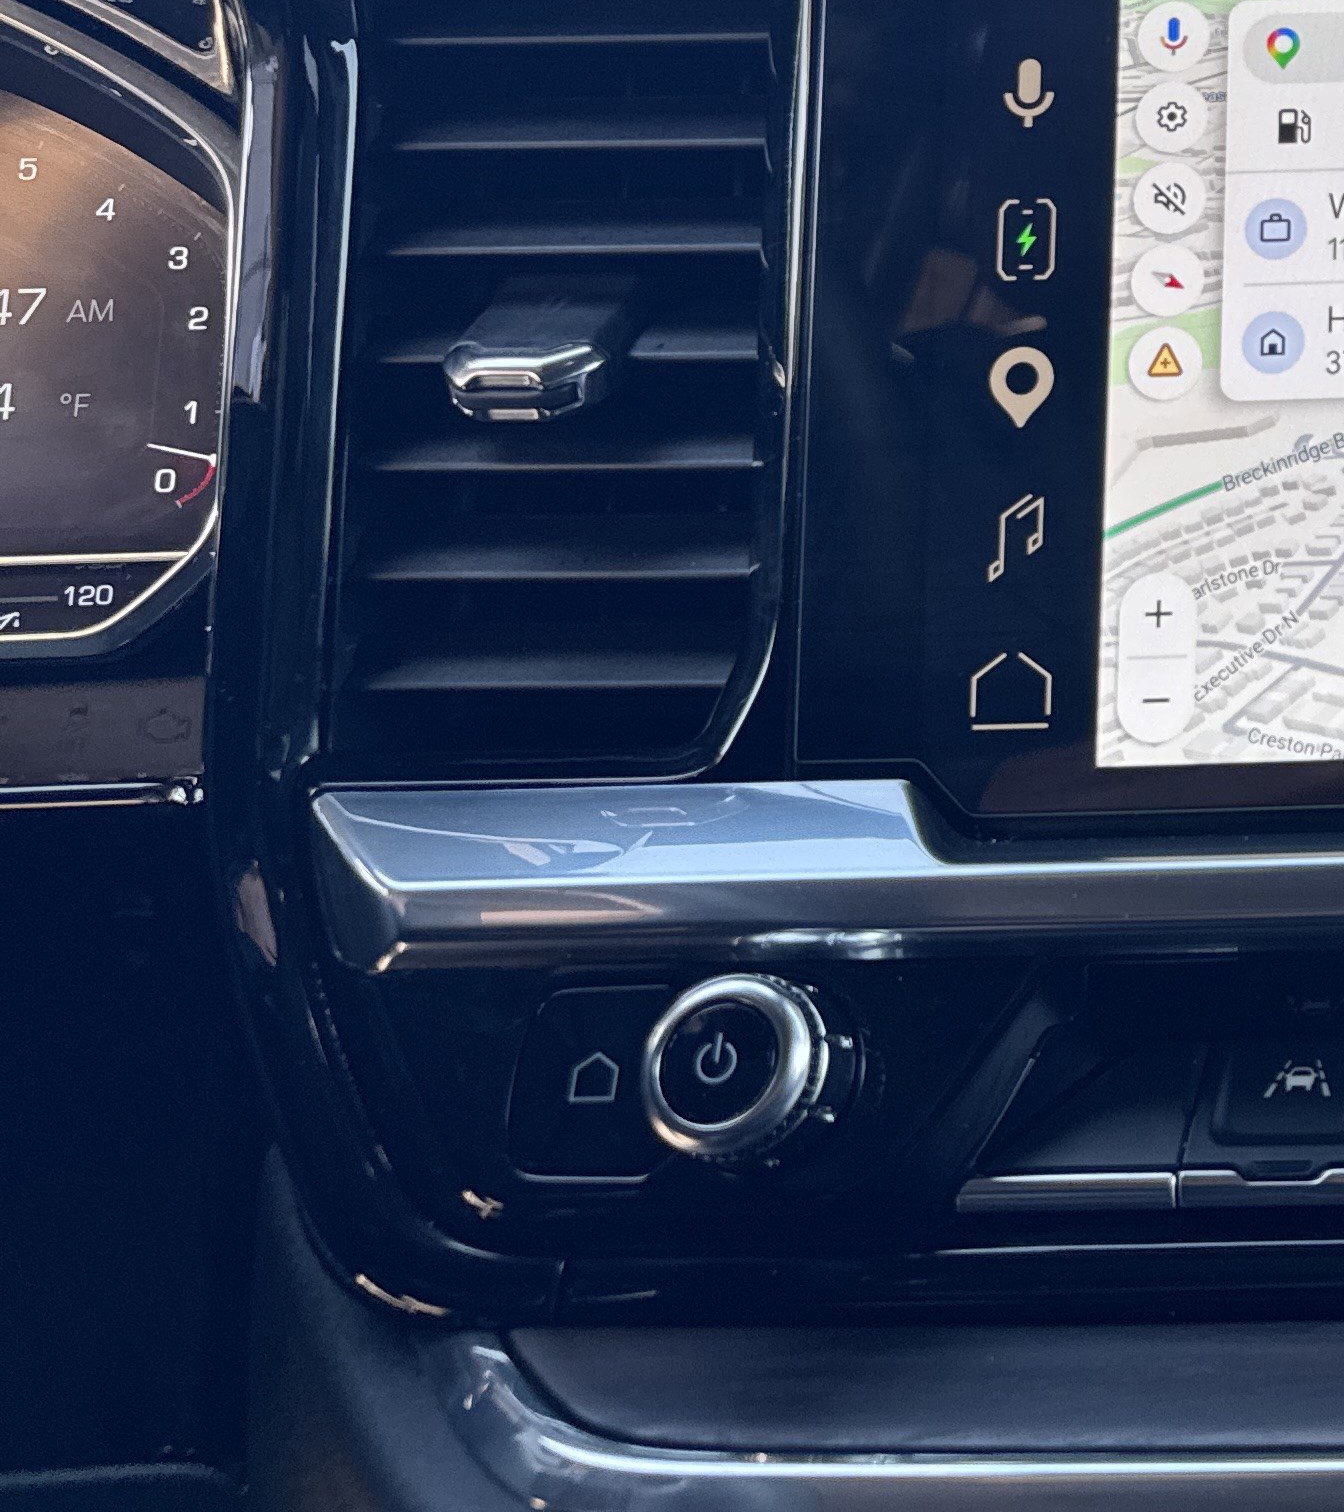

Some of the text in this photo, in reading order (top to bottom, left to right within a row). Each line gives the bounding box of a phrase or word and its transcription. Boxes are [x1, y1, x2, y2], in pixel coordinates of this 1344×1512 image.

[18, 158, 38, 180] 5
[96, 198, 116, 221] 4
[168, 246, 189, 270] 3
[66, 298, 114, 323] AM
[188, 306, 209, 330] 2
[184, 401, 198, 424] 1
[1222, 440, 1331, 492] Breckinridge
[155, 469, 176, 493] 0
[1263, 559, 1281, 576] Dr
[64, 584, 114, 606] 120
[1263, 623, 1284, 645] Dr
[1282, 610, 1300, 629] N
[1248, 727, 1315, 755] Creston
